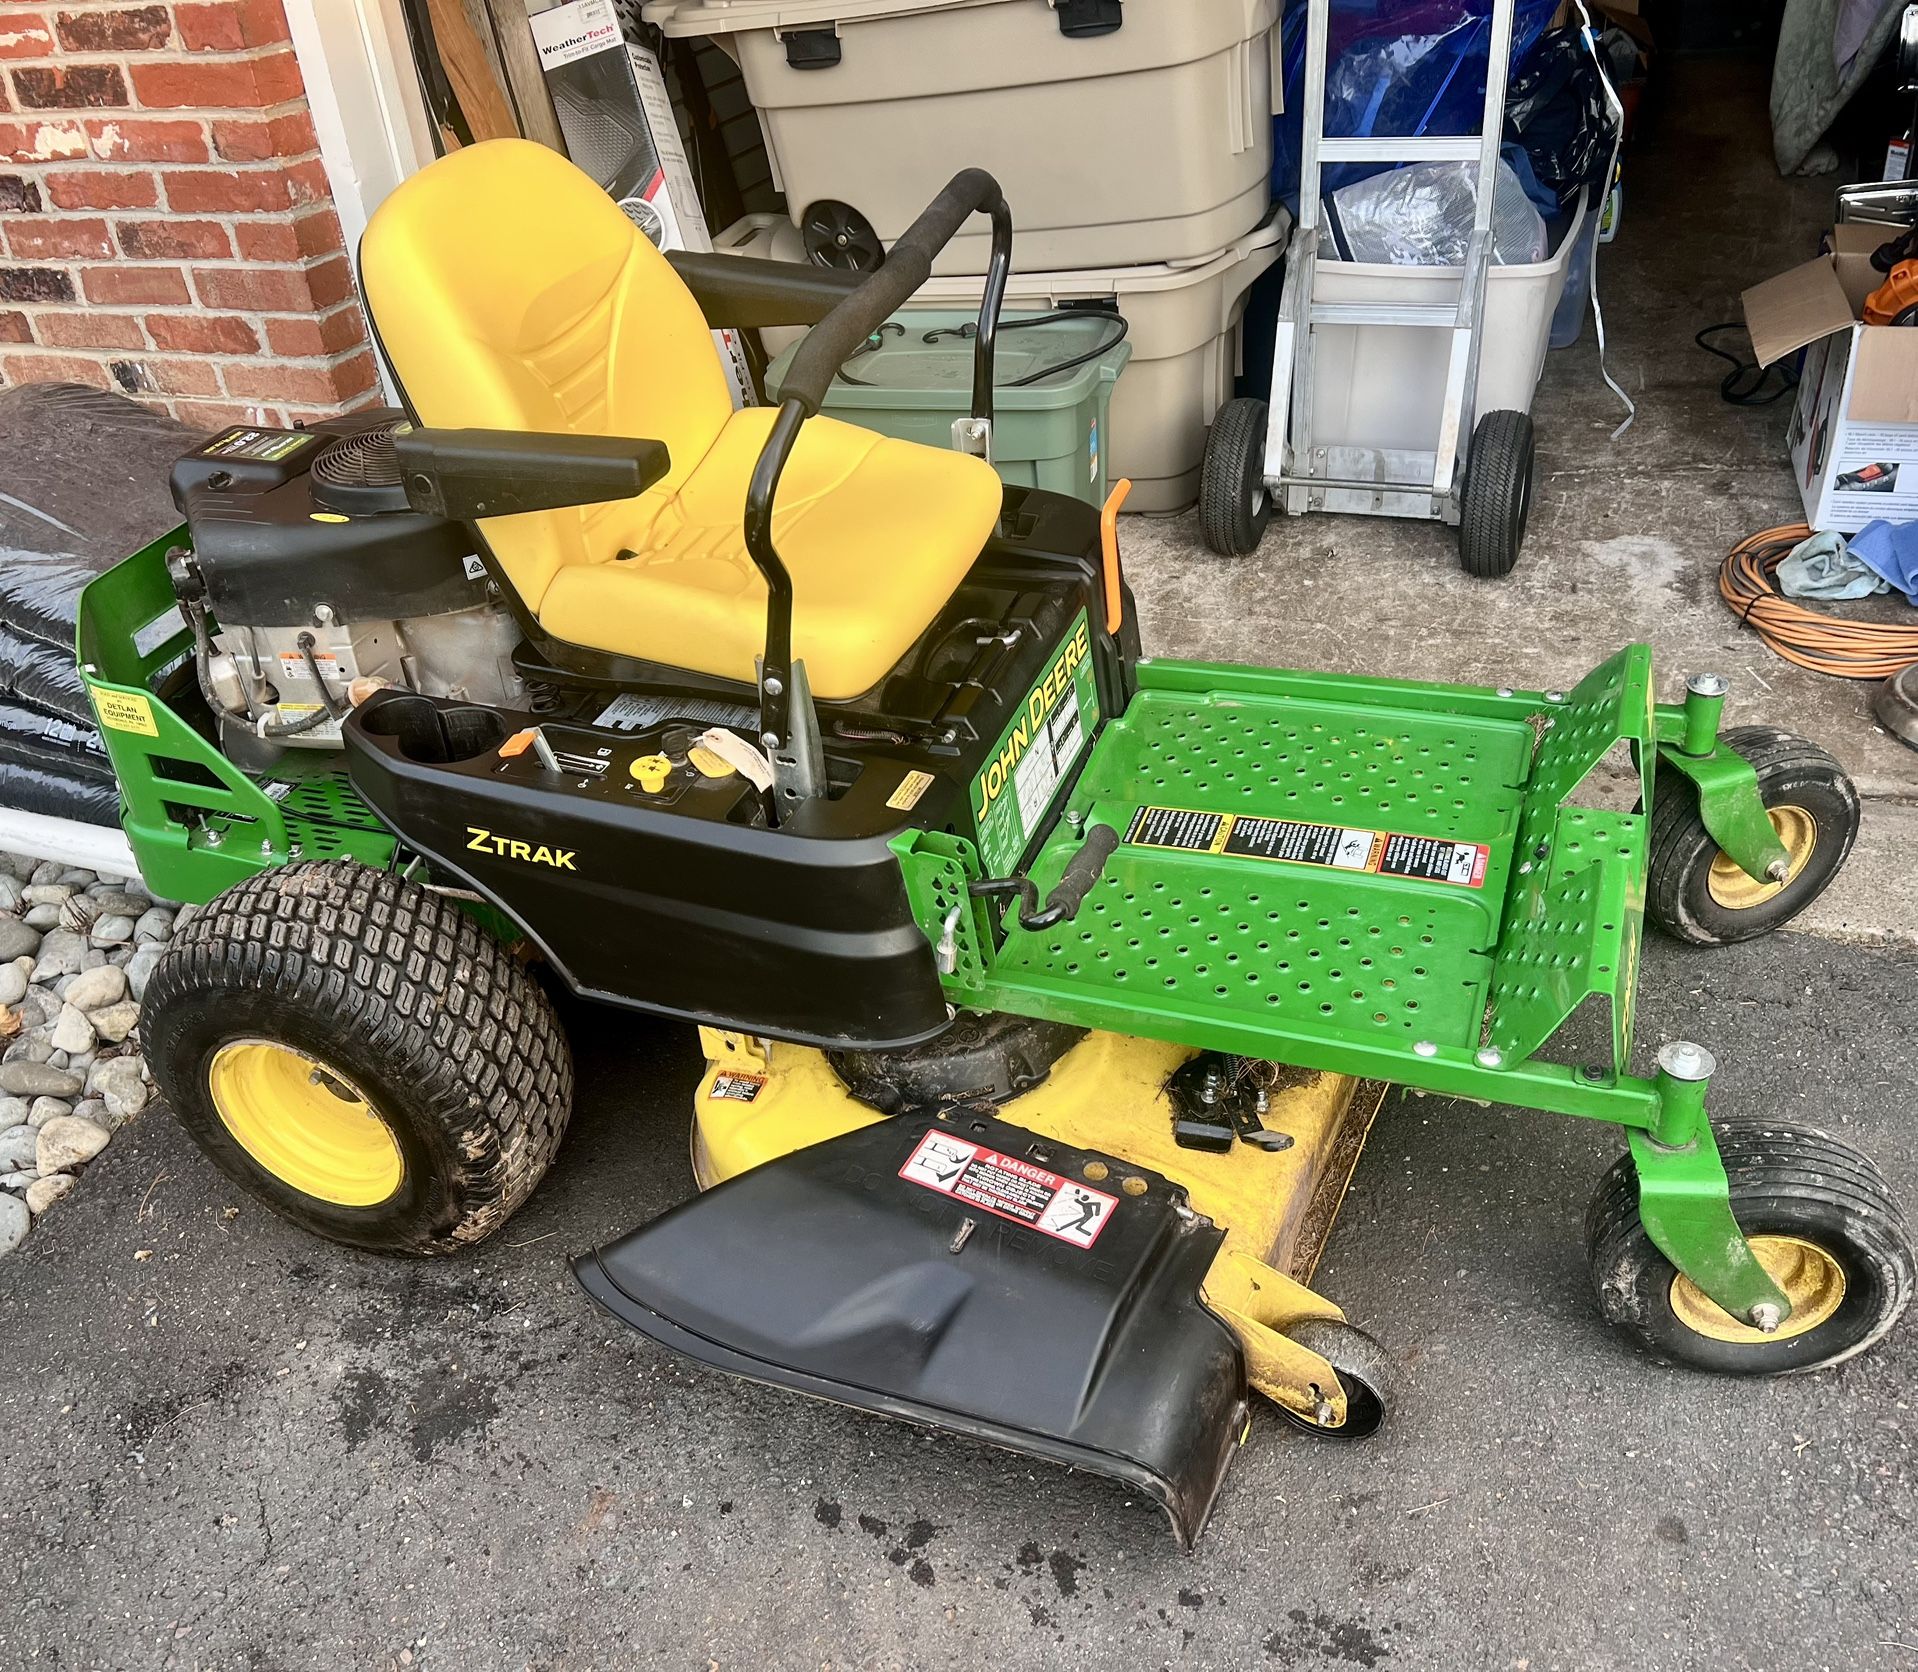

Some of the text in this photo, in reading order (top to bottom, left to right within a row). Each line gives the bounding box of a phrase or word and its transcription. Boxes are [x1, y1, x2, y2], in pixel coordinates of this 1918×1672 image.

[542, 24, 614, 55] WeatherTech
[103, 708, 146, 722] EQUIPMENT
[107, 702, 137, 713] DETLAN
[978, 715, 1029, 822] JOHN
[1028, 621, 1089, 733] DEERE
[467, 826, 577, 871] ZTRAK
[730, 1071, 766, 1083] WARNING
[983, 1163, 1041, 1188] ROTATING BLADE
[1000, 1157, 1056, 1185] DANGER
[974, 1174, 1036, 1200] THROWN OBJECTS
